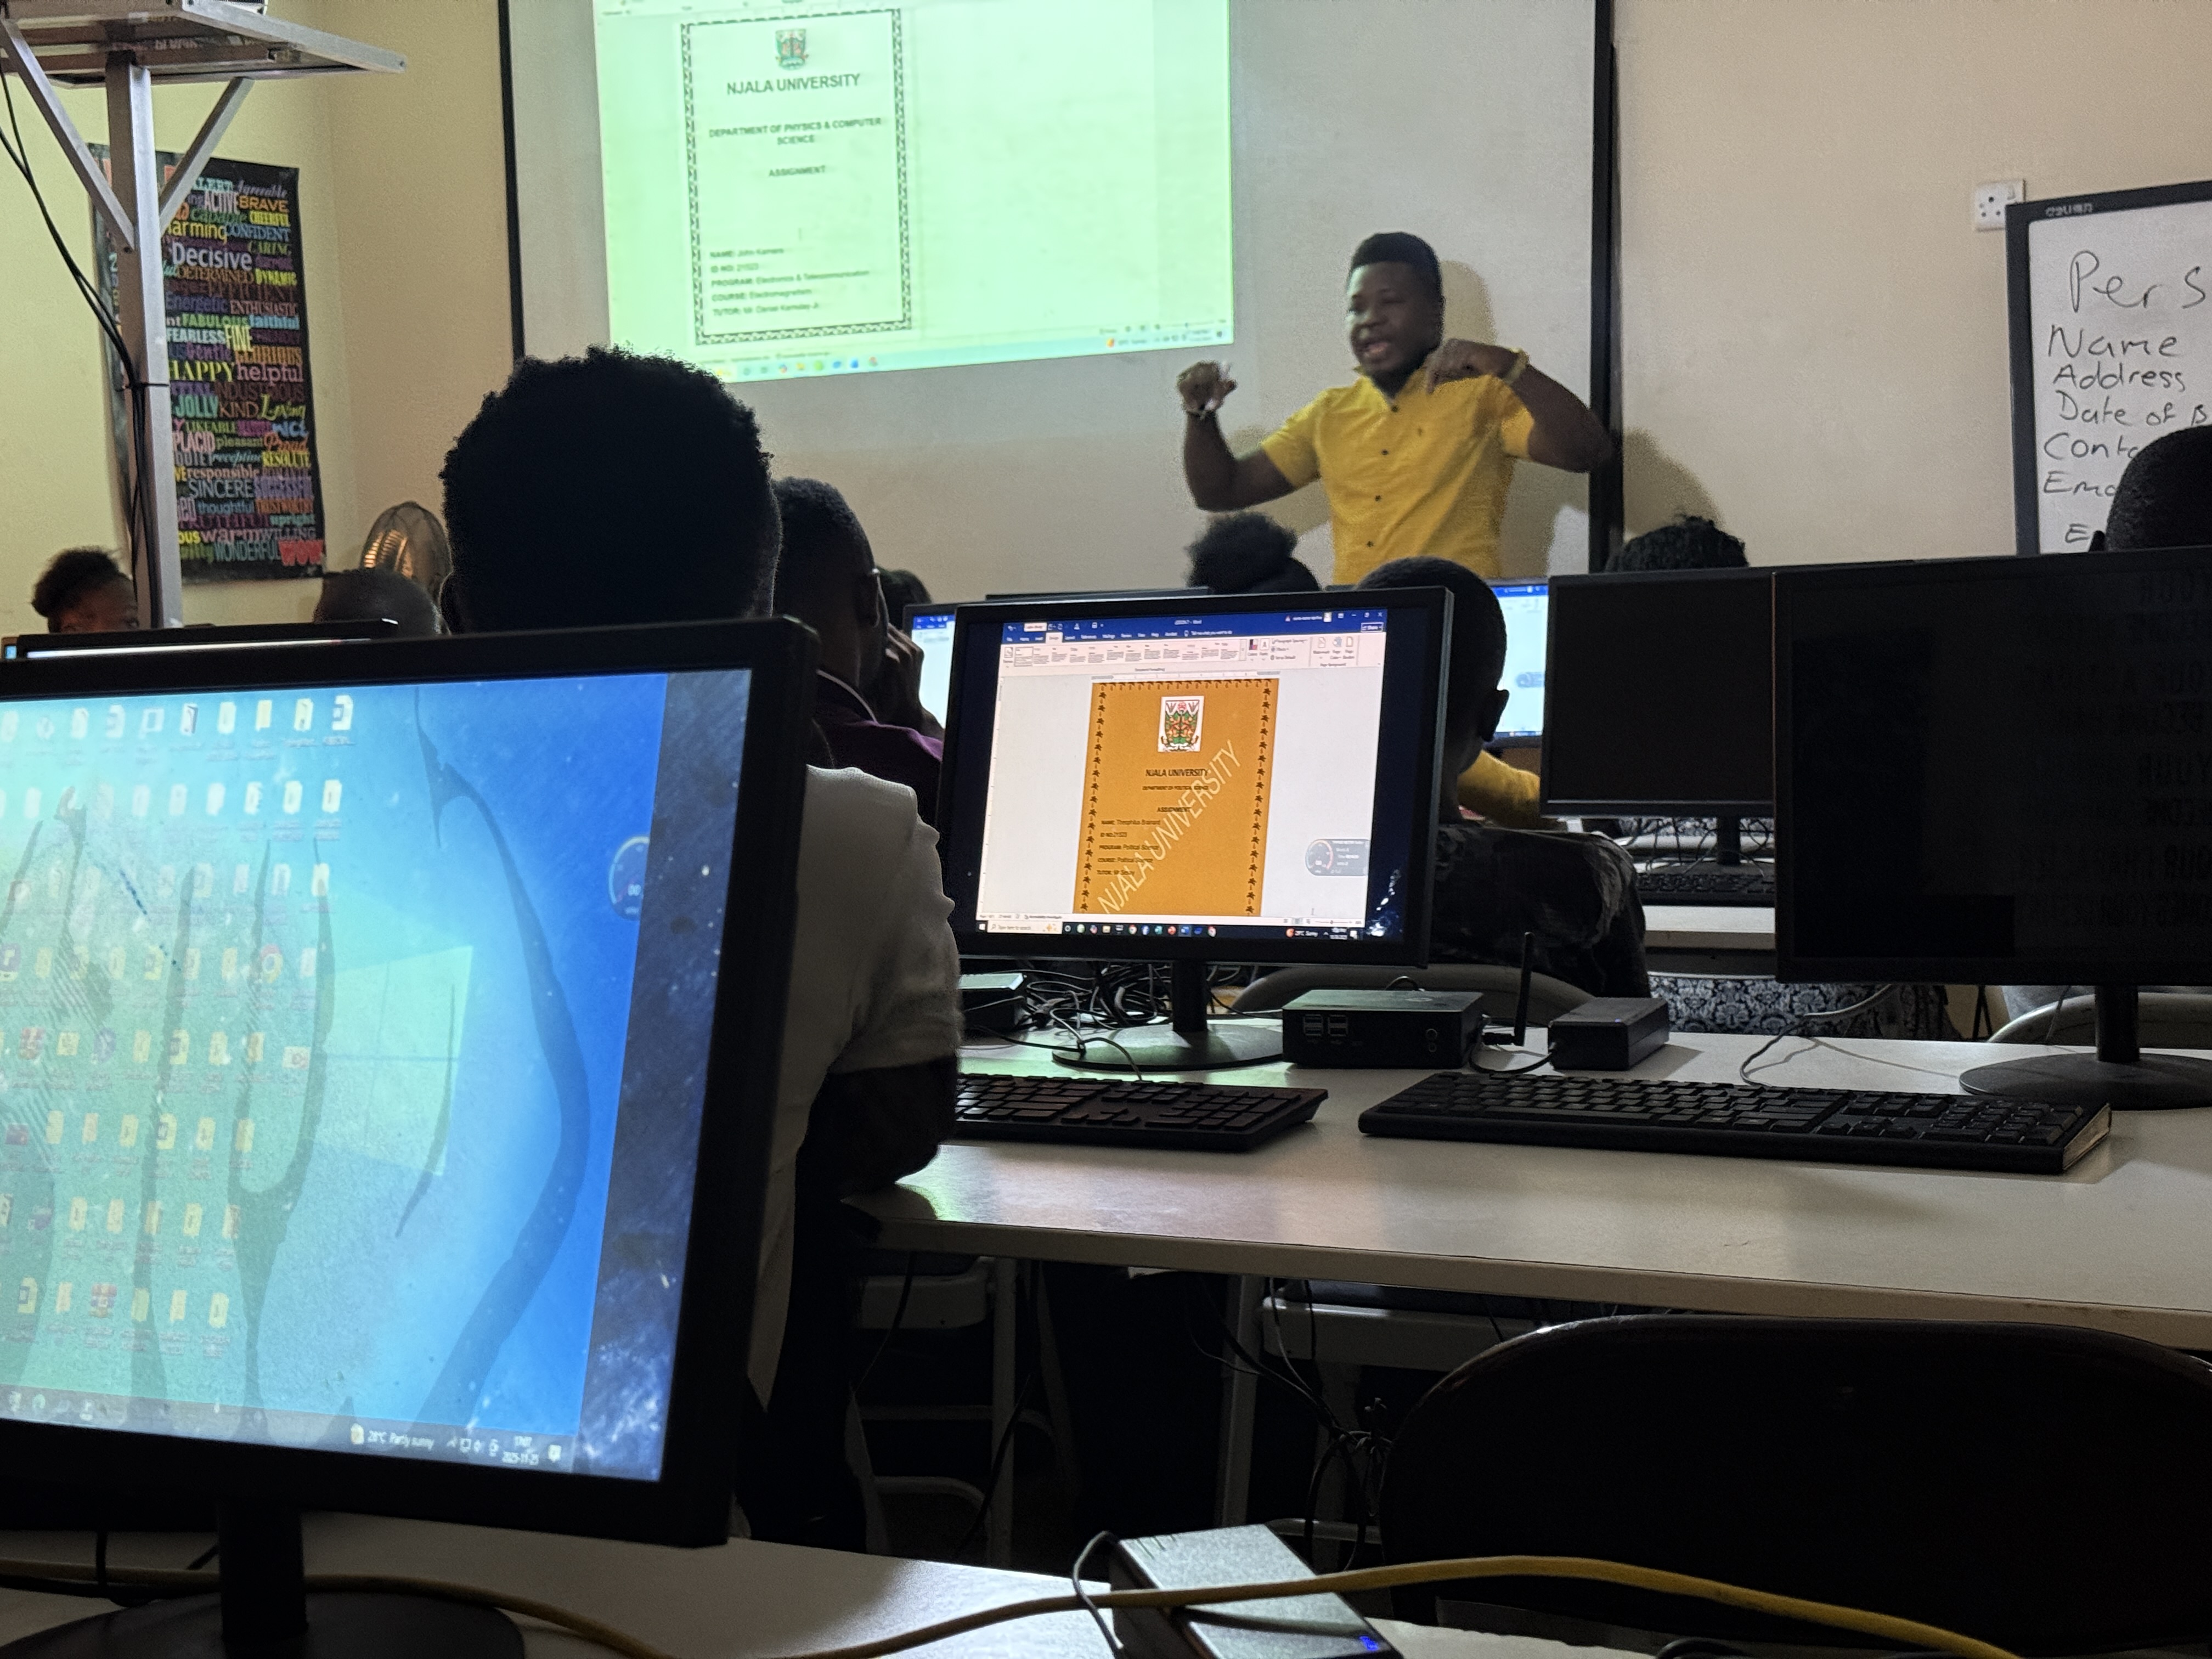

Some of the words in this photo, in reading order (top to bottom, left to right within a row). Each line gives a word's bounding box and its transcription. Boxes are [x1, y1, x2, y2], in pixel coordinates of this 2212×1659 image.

[727, 80, 774, 95] NJALA
[777, 74, 860, 91] UNIVERSITY
[709, 126, 768, 138] DEPARTMENT
[770, 125, 781, 133] OF
[785, 121, 822, 132] PHYSICS
[832, 117, 881, 129] COMPUTER
[777, 135, 814, 145] SCIENCE
[769, 165, 826, 177] ASSIGNMENT
[239, 195, 289, 213] BRAVE
[225, 223, 291, 242] CONFIDENT
[172, 241, 253, 272] Decisive
[178, 266, 255, 284] DETERMINED
[182, 312, 250, 328] FABULOUS
[167, 328, 226, 344] FEARLESS
[224, 325, 253, 352] FINE
[2048, 325, 2181, 358] Name
[170, 359, 235, 382] HAPPY
[236, 363, 303, 387] helpful
[2053, 361, 2185, 392] Address
[175, 394, 218, 418] JOLLY
[219, 401, 259, 419] KIND
[2055, 390, 2133, 427] Date
[2146, 402, 2176, 426] of
[172, 432, 216, 453] PLACID
[187, 464, 260, 483] responsible
[188, 478, 254, 499] SINCERE
[201, 528, 262, 544] warm
[214, 539, 281, 562] WONDERFUL
[1168, 768, 1207, 777] UNIVERSITY
[1097, 851, 1154, 914] NJALA
[1144, 739, 1240, 861] UNIVERSITY
